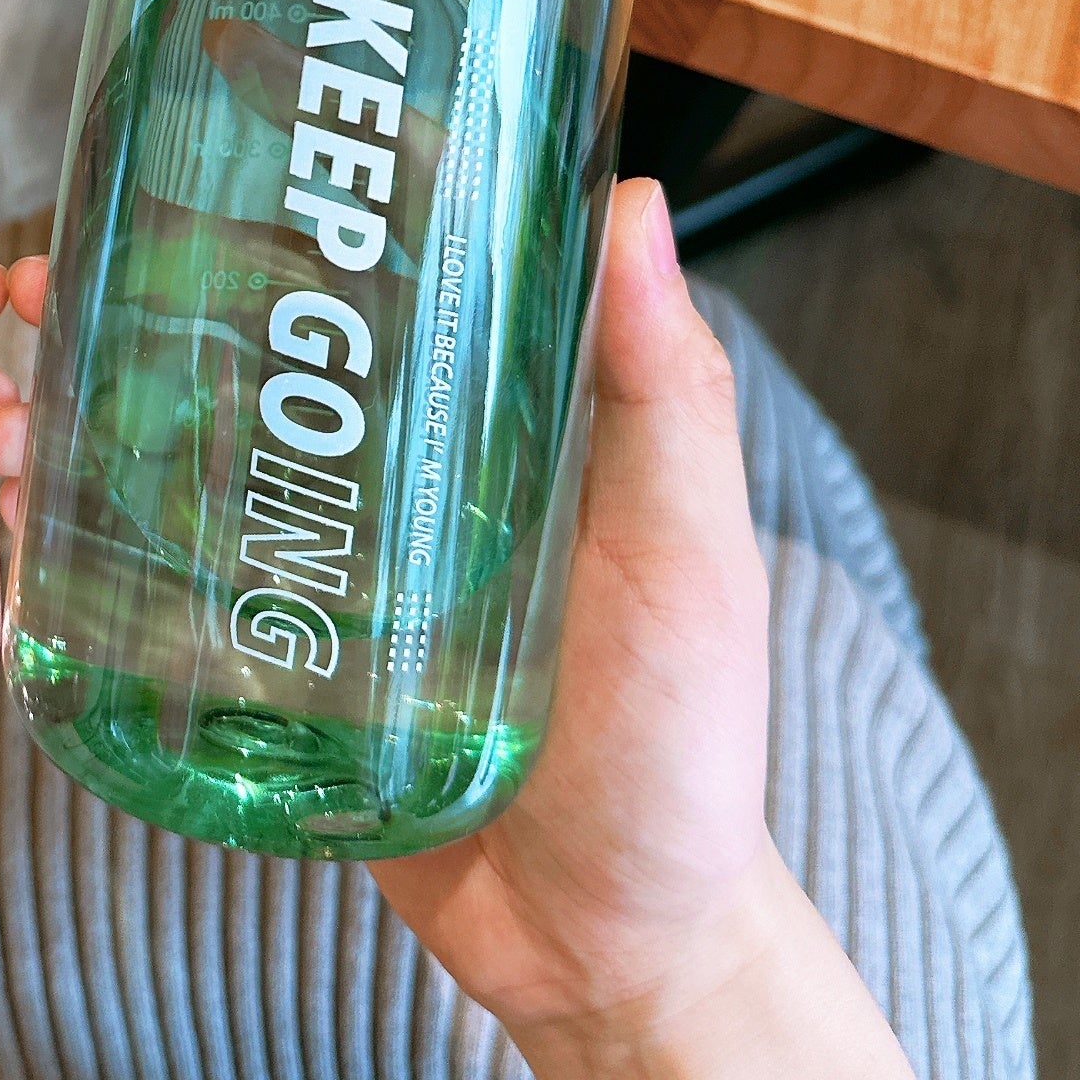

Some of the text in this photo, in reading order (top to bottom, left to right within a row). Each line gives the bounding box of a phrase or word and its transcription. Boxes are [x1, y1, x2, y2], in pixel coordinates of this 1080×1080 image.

[439, 246, 467, 308] LOVE
[437, 308, 459, 333] IT
[425, 333, 457, 436] BECAUSE
[229, 290, 373, 679] GOING
[408, 486, 440, 567] YOUNG
